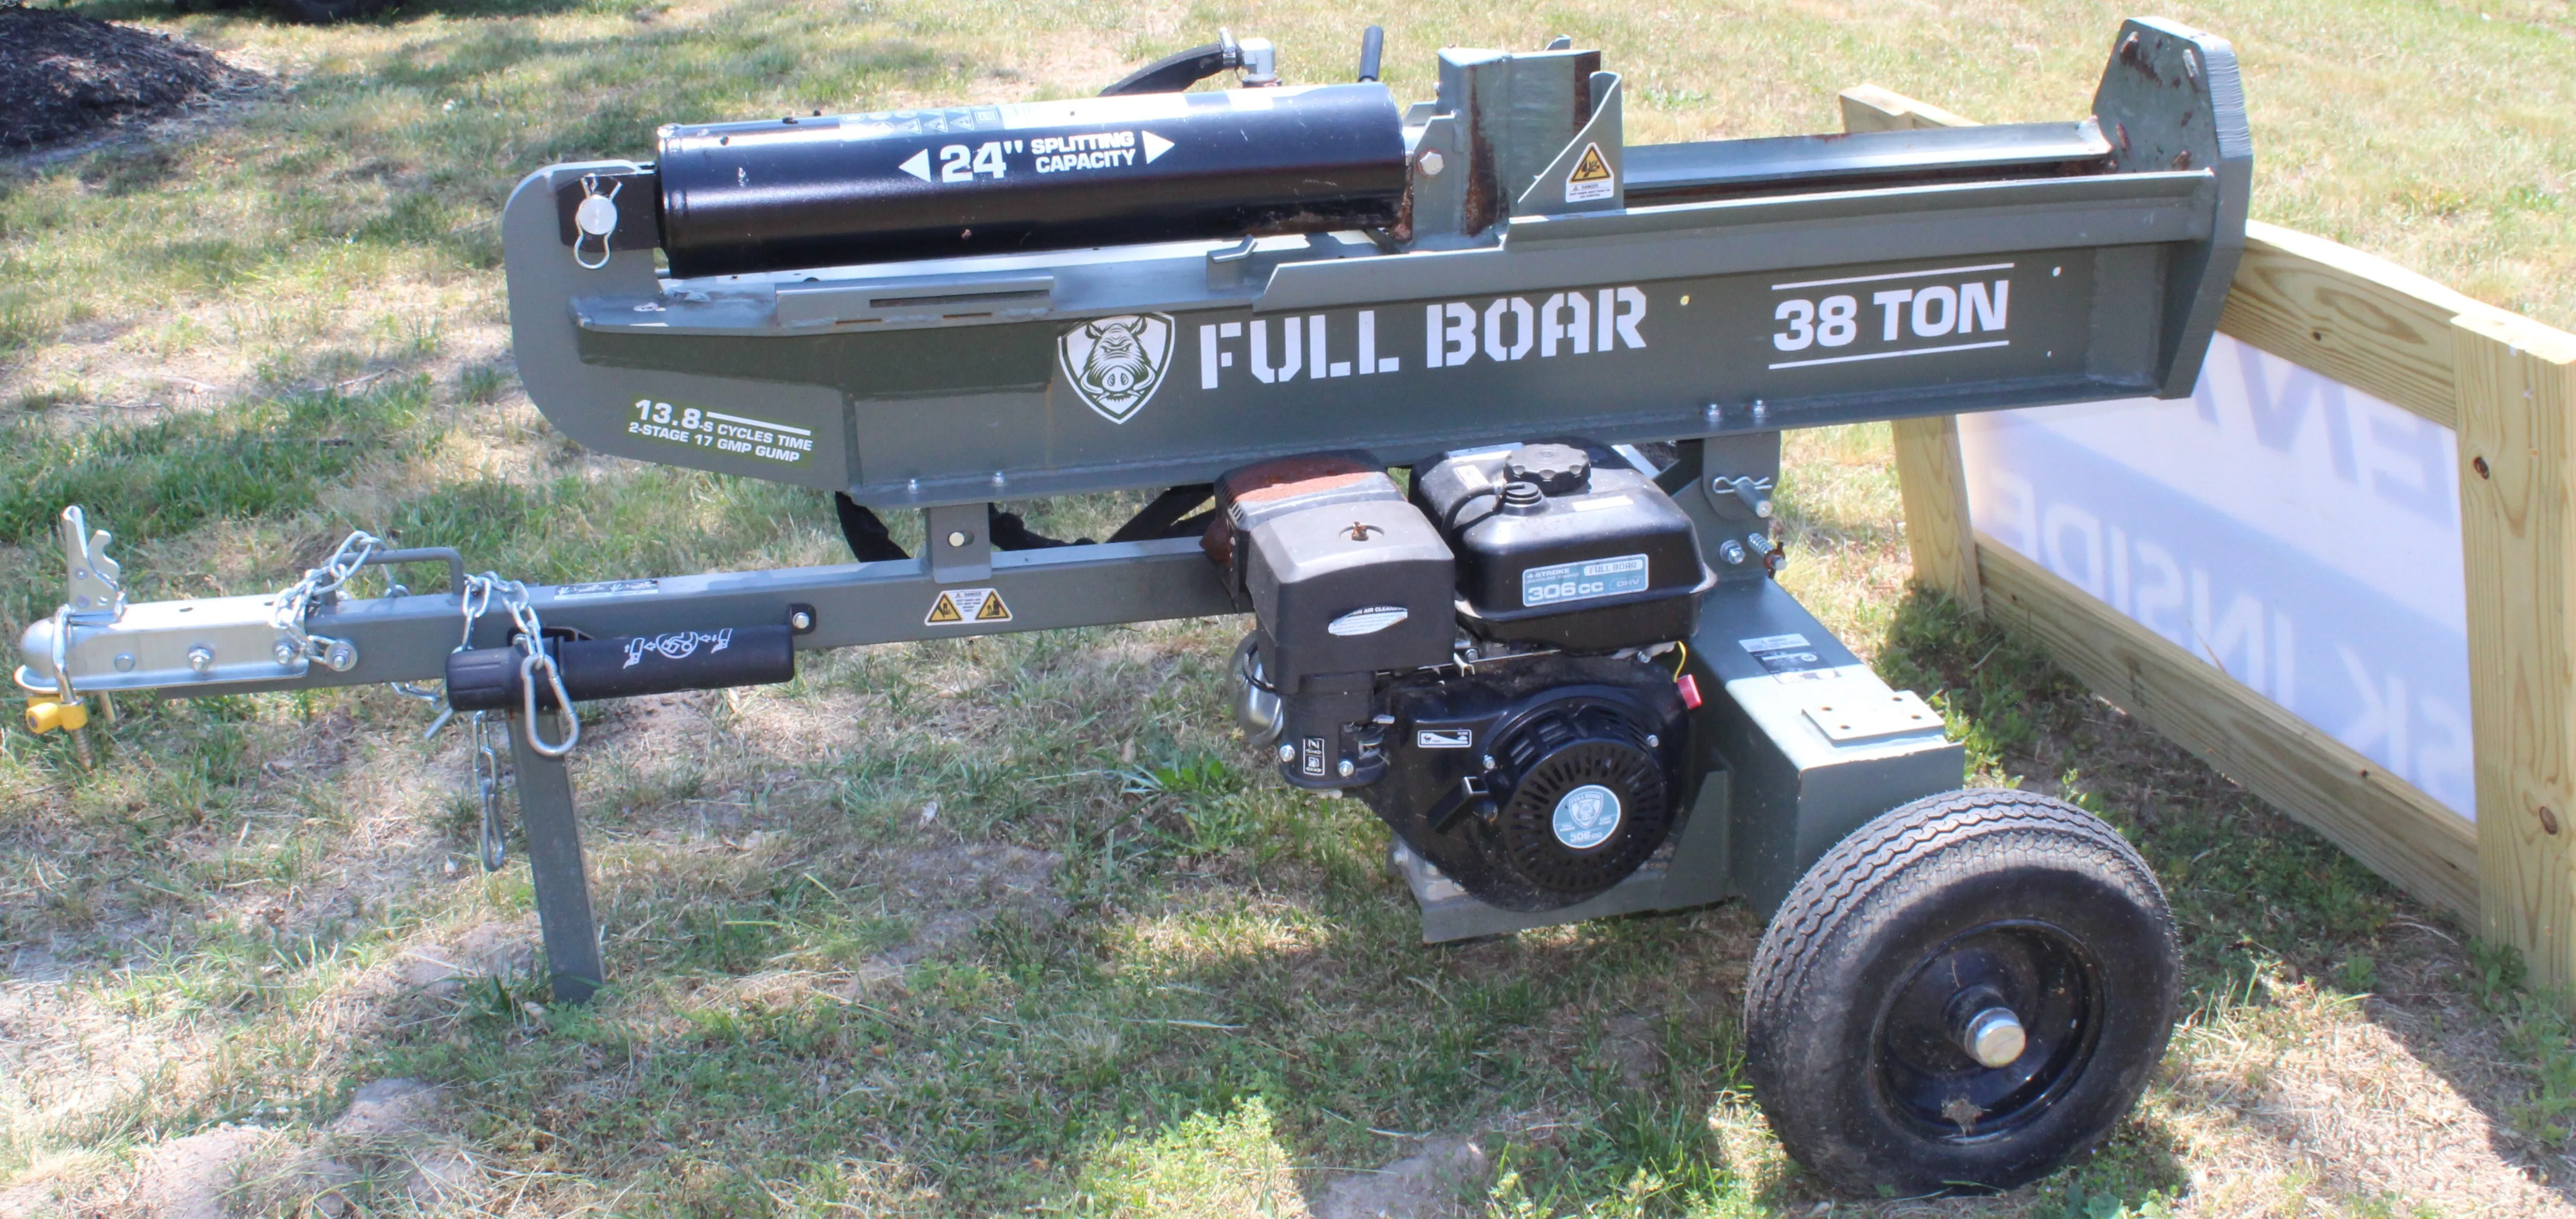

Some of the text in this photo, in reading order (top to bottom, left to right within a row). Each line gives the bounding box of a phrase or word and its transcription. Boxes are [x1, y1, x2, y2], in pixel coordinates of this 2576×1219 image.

[1031, 131, 1135, 155] SPLITTING
[939, 140, 1023, 183] 24"
[1036, 148, 1136, 174] CAPACITY
[1773, 279, 2009, 352] 38 TON
[1200, 286, 1647, 390] FULL BOAR
[628, 421, 800, 462] 2-STAGE 17 GMP GUMP
[717, 425, 773, 444] CYCLES
[777, 434, 813, 451] TIME
[1527, 568, 1570, 579] 4-STROKE
[1589, 561, 1637, 574] FULL BOAR
